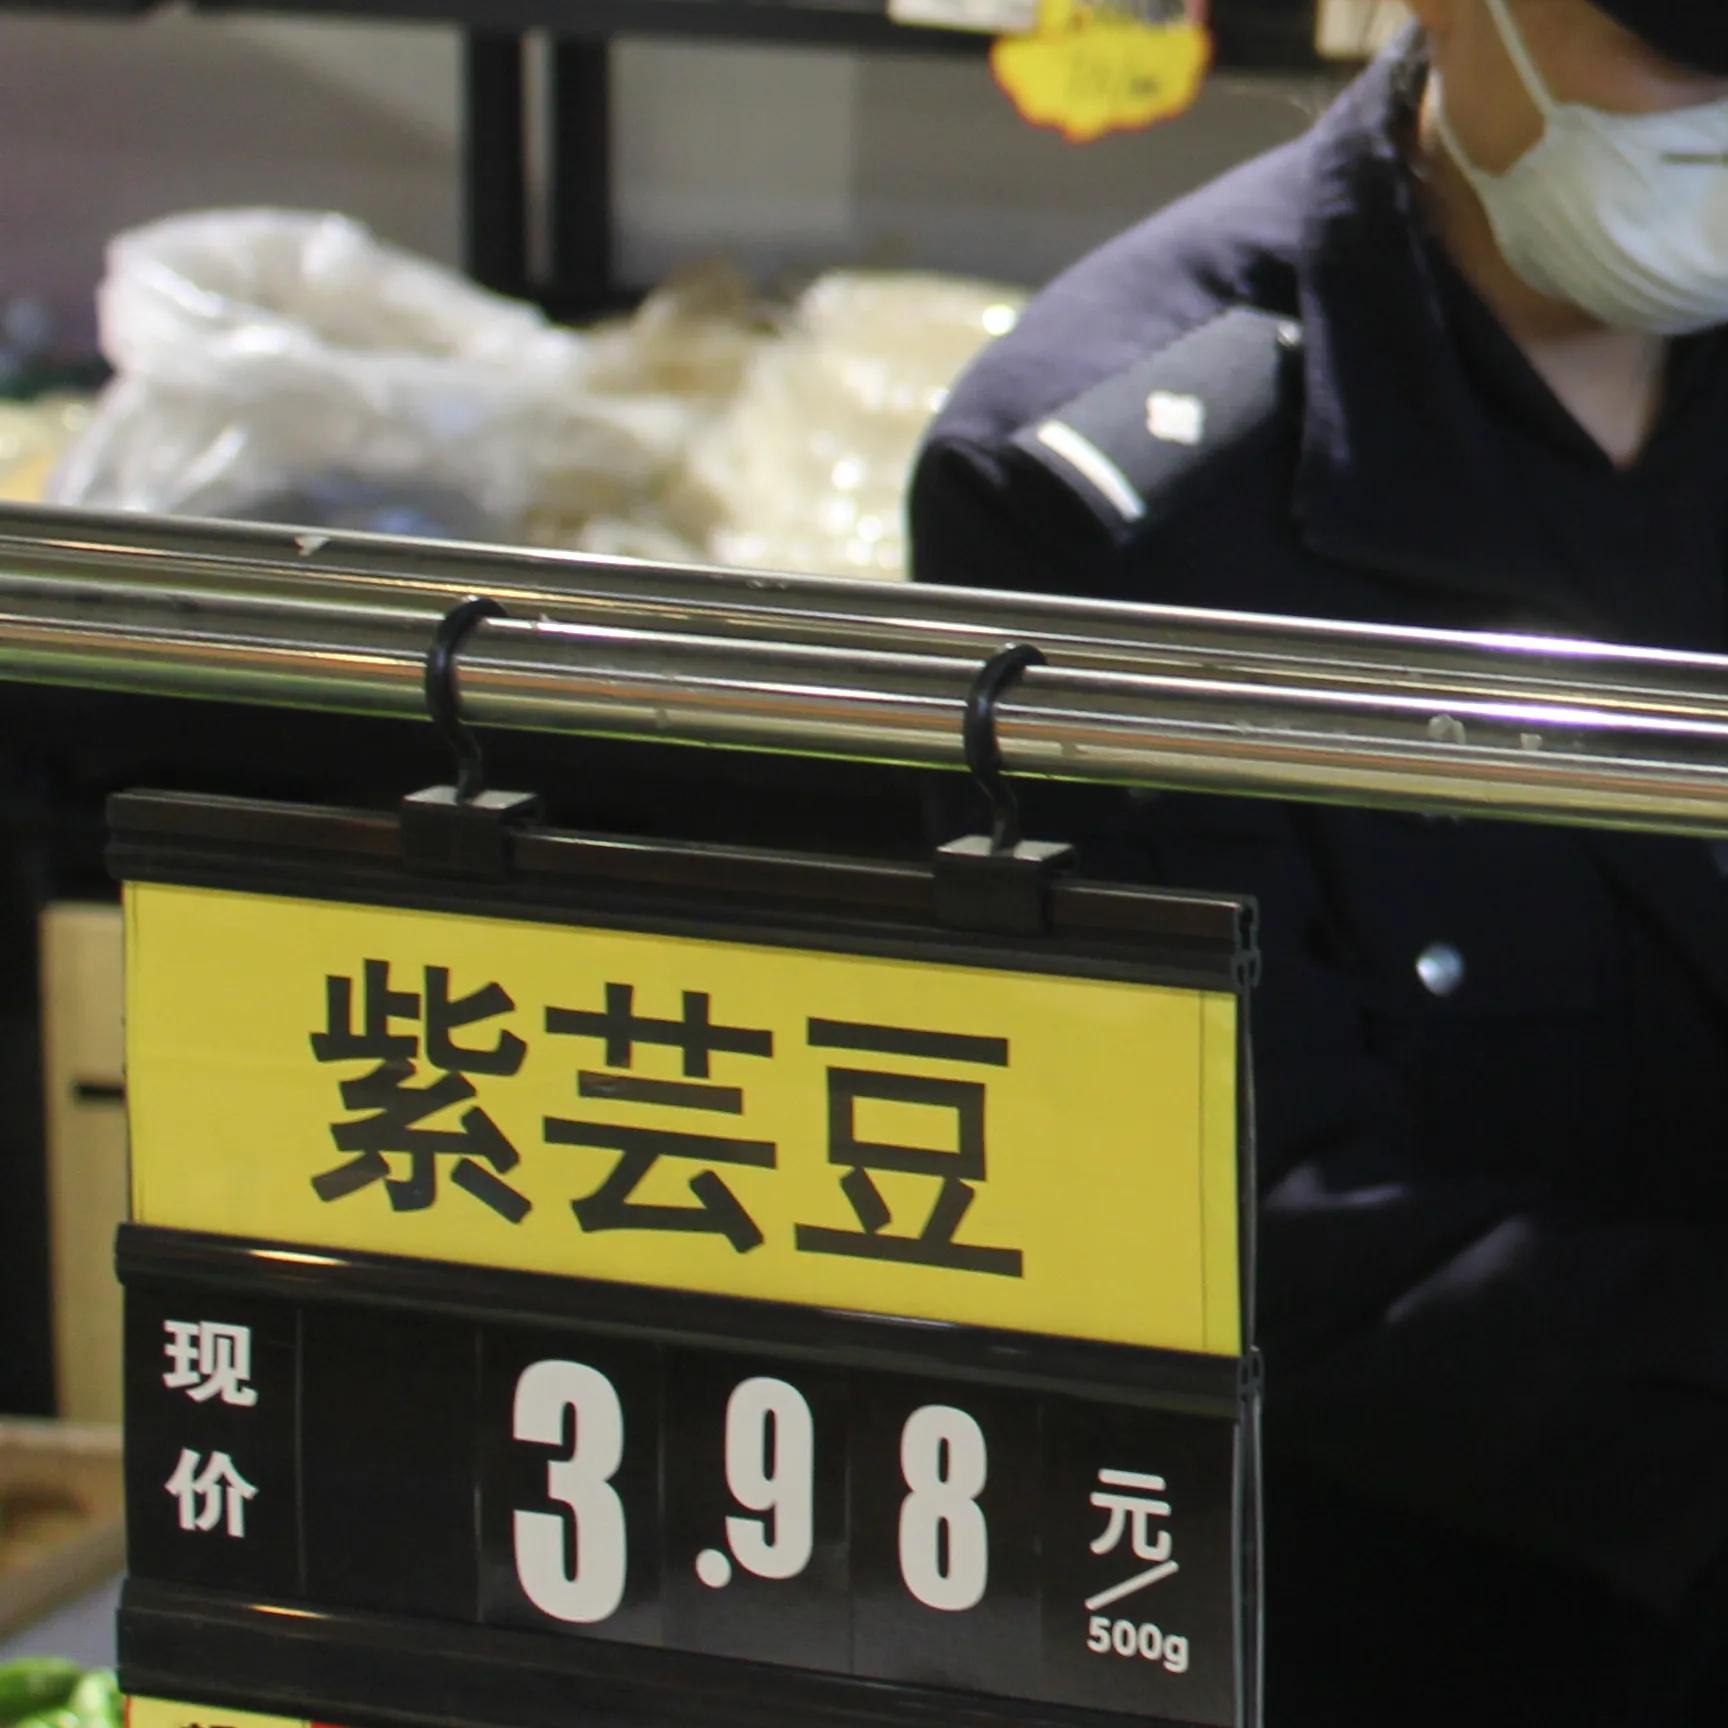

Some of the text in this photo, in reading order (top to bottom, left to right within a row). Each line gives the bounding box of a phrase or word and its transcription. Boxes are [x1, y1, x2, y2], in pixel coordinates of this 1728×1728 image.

[310, 957, 1025, 1278] 紫芸豆
[512, 1358, 990, 1624] 3.98
[1086, 1614, 1191, 1673] 500g
